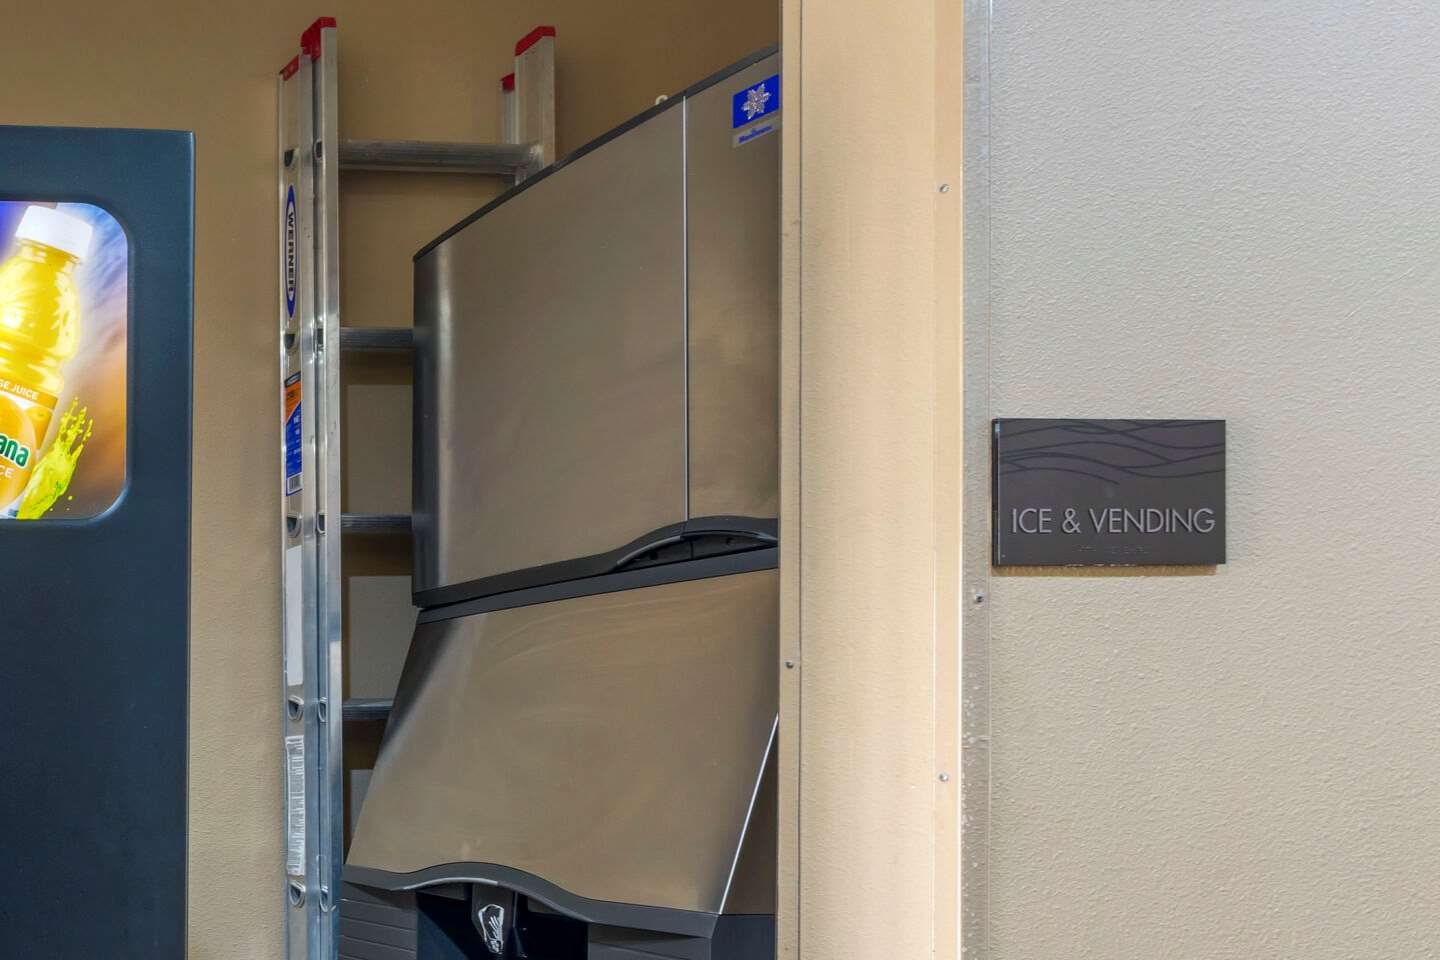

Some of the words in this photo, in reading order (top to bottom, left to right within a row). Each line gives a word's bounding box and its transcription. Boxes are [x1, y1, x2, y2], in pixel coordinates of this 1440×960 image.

[11, 384, 40, 401] JUICE
[1012, 507, 1052, 534] ICE
[1062, 507, 1081, 534] &
[1089, 507, 1216, 534] VENDING
